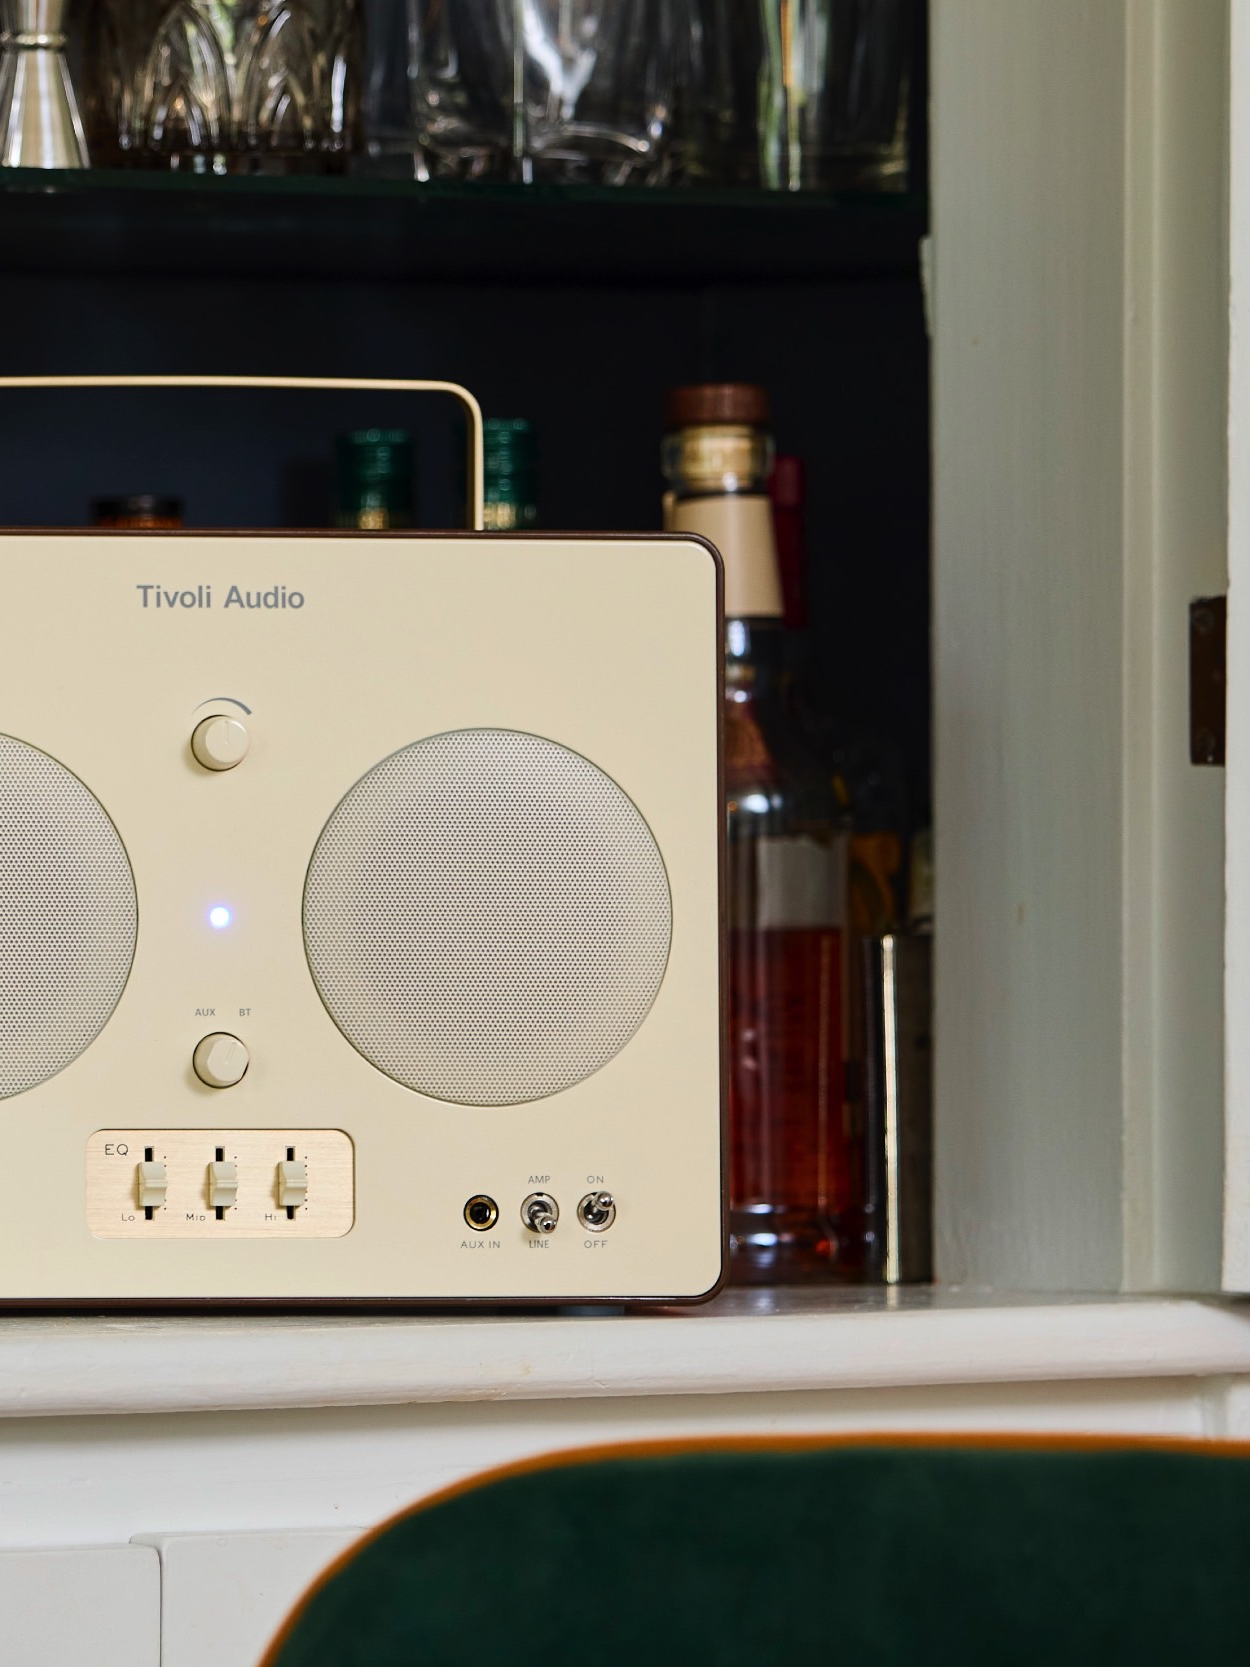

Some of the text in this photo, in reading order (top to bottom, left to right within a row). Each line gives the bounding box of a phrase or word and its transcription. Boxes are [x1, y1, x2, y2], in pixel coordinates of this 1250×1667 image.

[136, 585, 305, 609] Tivoli Audio
[194, 1008, 252, 1017] AUX BT
[105, 1143, 129, 1156] EQ
[527, 1175, 551, 1185] AMP
[586, 1175, 604, 1184] ON
[460, 1240, 501, 1249] AUX IN
[528, 1240, 550, 1249] LINE
[583, 1240, 608, 1249] OFF
